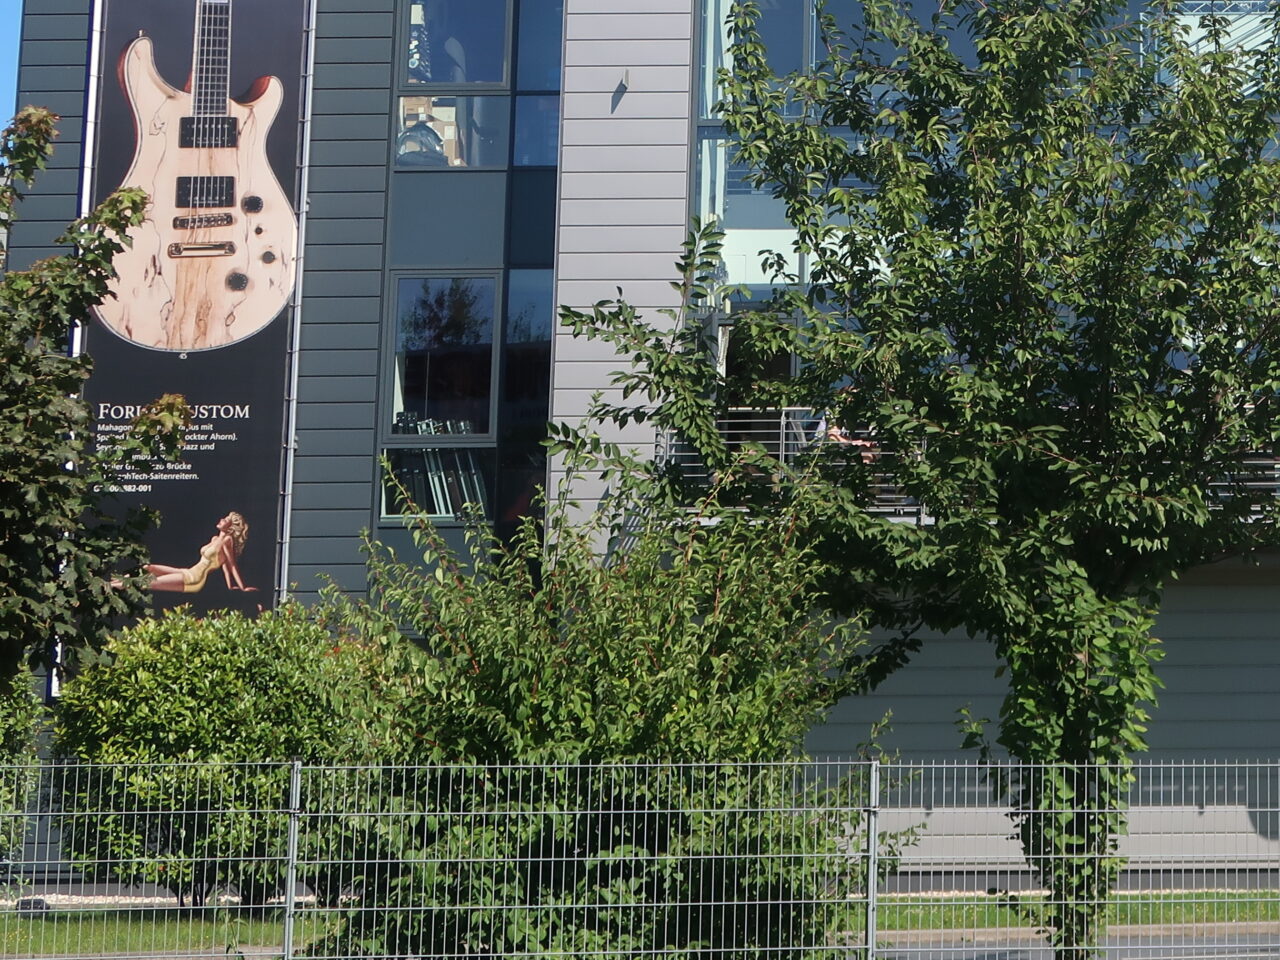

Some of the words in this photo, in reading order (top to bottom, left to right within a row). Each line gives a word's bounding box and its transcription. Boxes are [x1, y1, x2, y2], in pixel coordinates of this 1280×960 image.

[98, 403, 160, 419] FOR
[174, 405, 250, 419] USTOM
[97, 423, 135, 433] Mahagon
[200, 422, 214, 431] mit
[210, 432, 238, 442] Ahorn).
[200, 442, 215, 451] und
